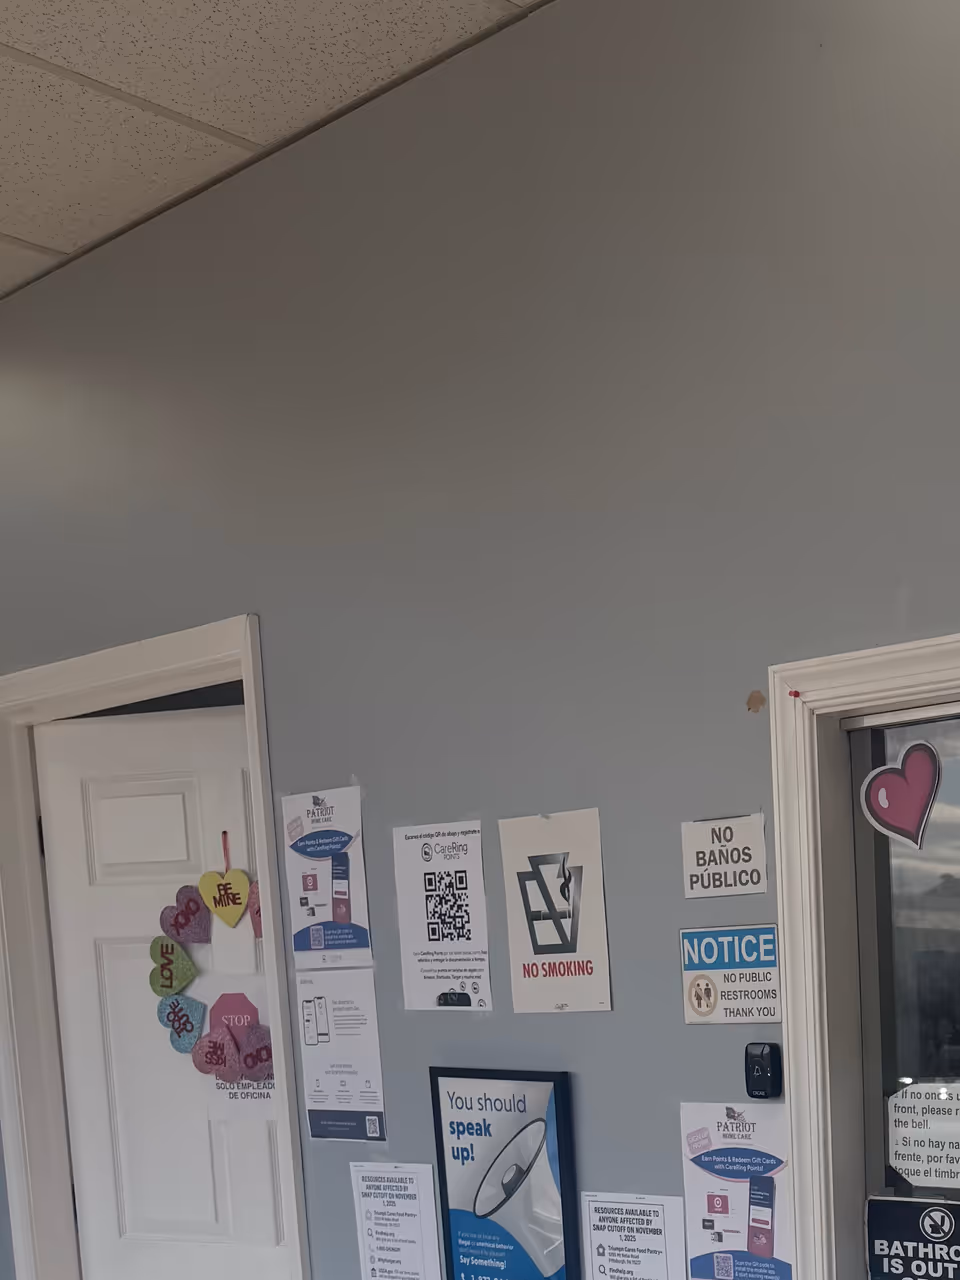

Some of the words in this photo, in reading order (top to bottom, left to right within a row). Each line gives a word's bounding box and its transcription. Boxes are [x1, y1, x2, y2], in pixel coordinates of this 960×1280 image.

[307, 806, 334, 818] PATRIOT
[711, 826, 733, 844] NO
[434, 842, 468, 855] CareRing
[696, 844, 753, 867] BAÑOS
[690, 868, 761, 890] PÚBLICO
[217, 883, 232, 895] BE
[213, 893, 242, 908] MINE
[170, 898, 200, 936] XOXO
[683, 934, 775, 965] NOTICE
[160, 944, 174, 988] LOVE
[523, 963, 539, 978] NO
[541, 960, 593, 977] SMOKING
[723, 973, 737, 983] NO
[739, 971, 772, 983] PUBLIC
[720, 989, 777, 1001] RESTROOMS
[723, 1007, 754, 1018] THANK
[757, 1006, 776, 1017] YOU
[222, 1015, 250, 1026] STOP
[902, 1089, 907, 1099] If
[911, 1091, 921, 1099] no
[447, 1091, 473, 1110] You
[478, 1092, 526, 1113] should
[894, 1103, 918, 1115] front,
[922, 1105, 952, 1116] please
[449, 1118, 492, 1140] speak
[716, 1122, 756, 1133] PATRIOT
[894, 1118, 908, 1128] the
[912, 1119, 930, 1129] bell.
[902, 1136, 910, 1146] Si
[929, 1138, 946, 1151] hay
[451, 1143, 475, 1166] up!
[894, 1151, 923, 1164] frente,
[927, 1155, 943, 1164] por
[924, 1168, 931, 1177] el
[594, 1207, 624, 1215] RESOURCES
[625, 1209, 652, 1217] AVAILABLE
[599, 1216, 618, 1224] ANYONE
[620, 1217, 645, 1225] AFFECTED
[607, 1225, 626, 1233] CUTOFF
[636, 1227, 662, 1235] NOVEMBER
[460, 1255, 470, 1266] Say
[471, 1256, 506, 1270] Something!
[882, 1257, 904, 1273] IS
[911, 1260, 958, 1279] OUT
